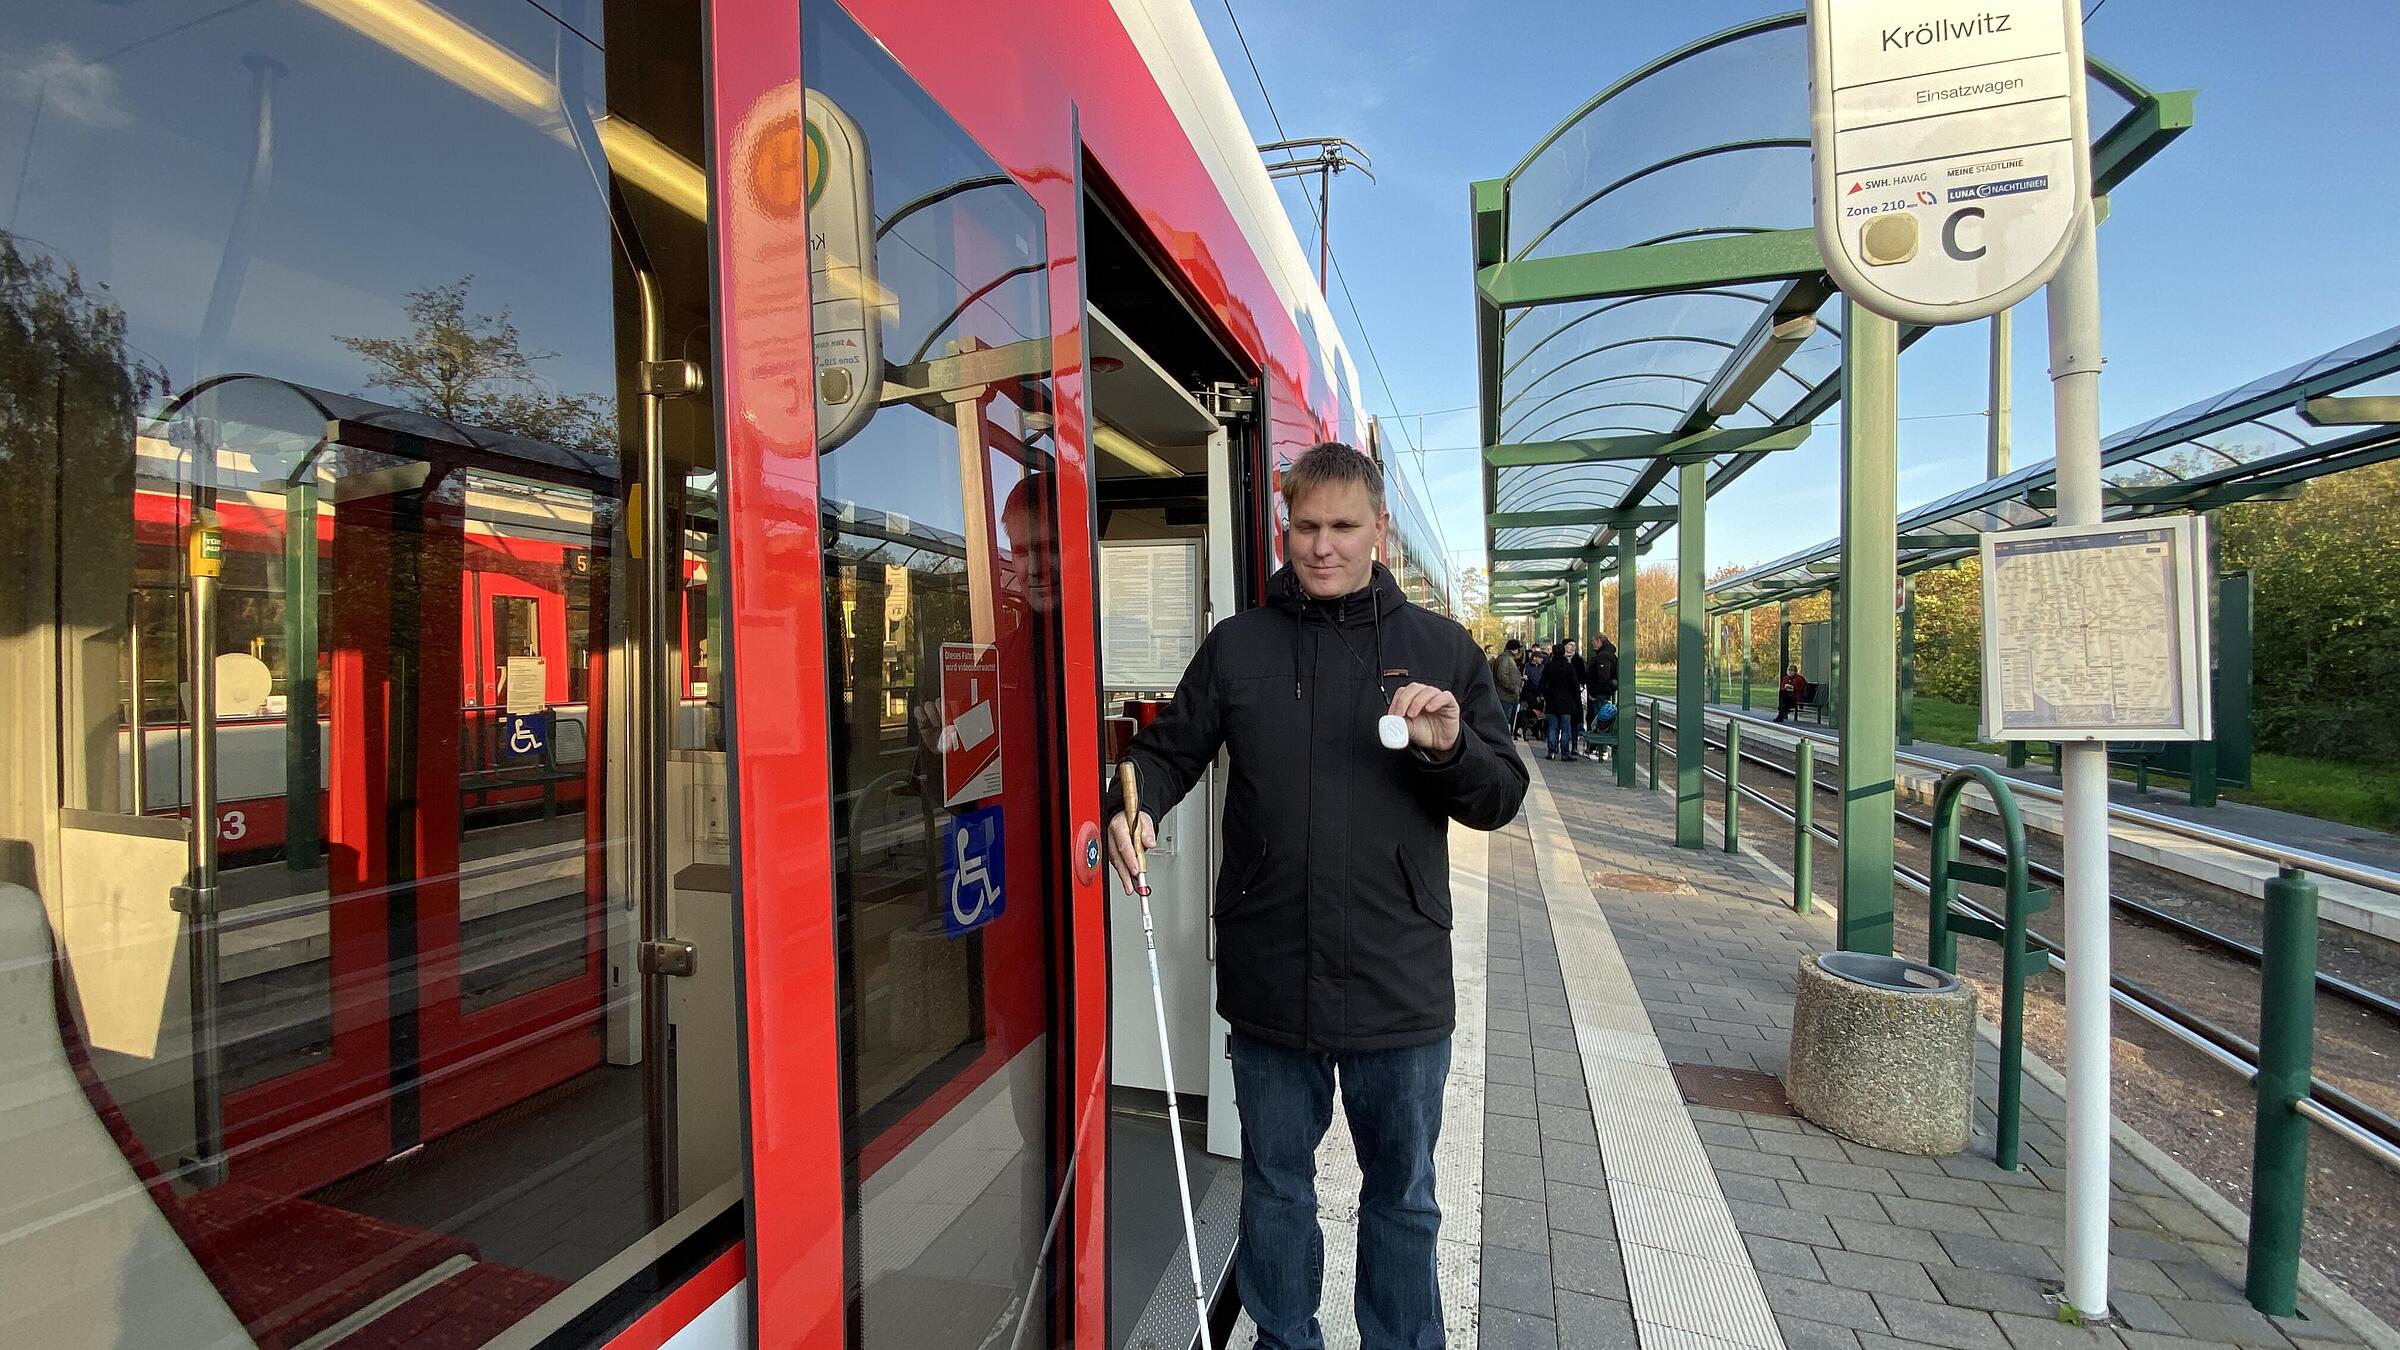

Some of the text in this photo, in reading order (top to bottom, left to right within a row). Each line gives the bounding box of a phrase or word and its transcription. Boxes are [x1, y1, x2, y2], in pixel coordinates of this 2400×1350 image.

[1882, 13, 2012, 51] Kröllwitz
[1916, 78, 2024, 103] Einsatzwagen
[1865, 172, 1927, 189] SWH. HAVAG
[1947, 166, 1974, 177] MEINE
[1949, 179, 2047, 199] LUNA NACHTLINIEN
[1847, 206, 1878, 217] Zone
[1882, 200, 1905, 212] 210
[1941, 206, 1987, 262] C
